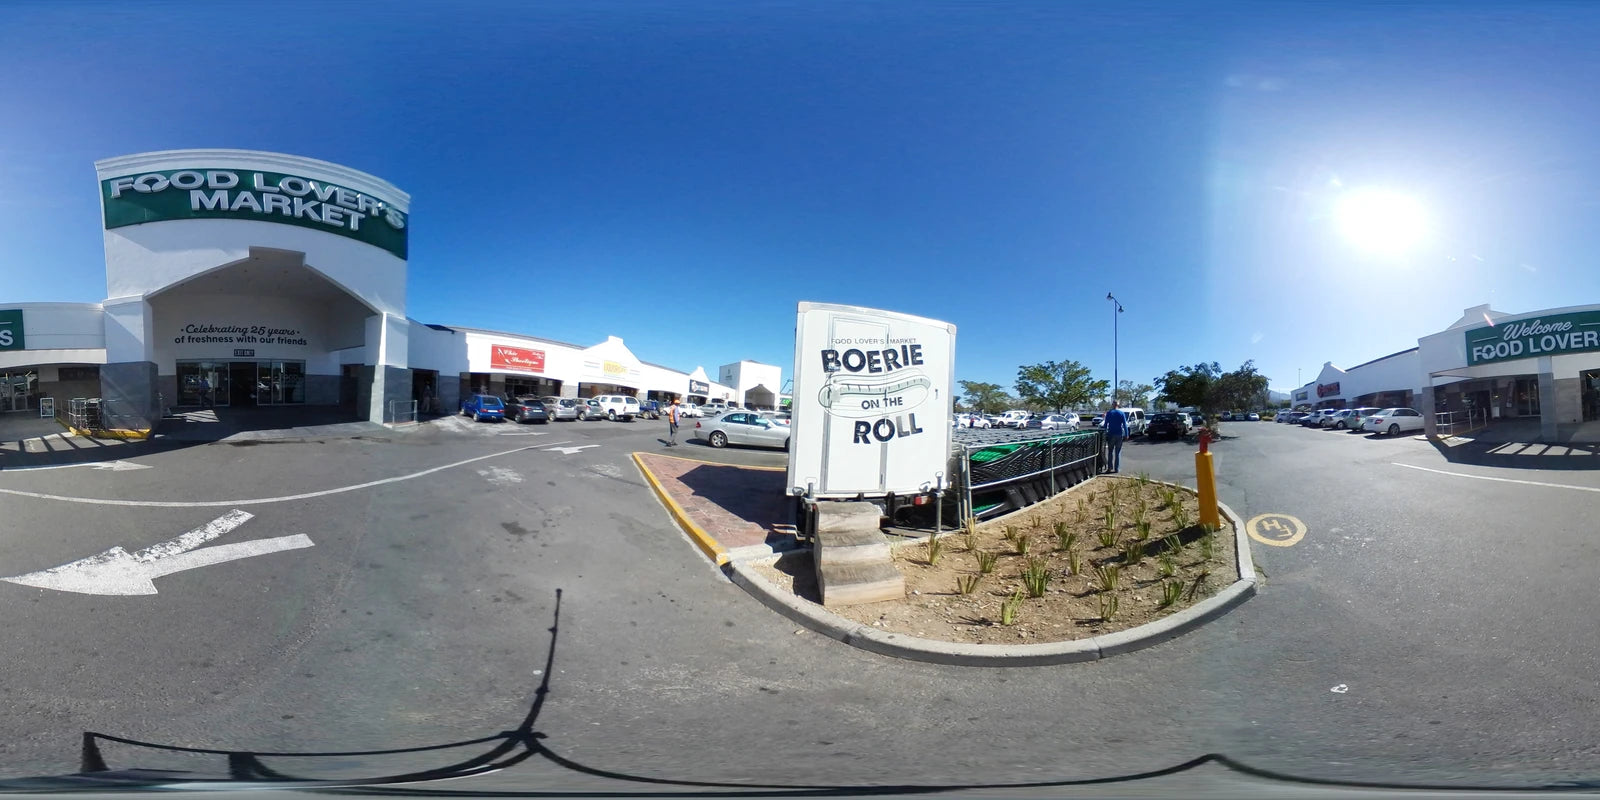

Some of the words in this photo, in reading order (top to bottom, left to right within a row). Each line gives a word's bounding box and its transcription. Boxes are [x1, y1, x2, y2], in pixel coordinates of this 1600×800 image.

[110, 170, 239, 198] FOOD
[254, 172, 405, 229] LOVER'S
[189, 189, 365, 231] MARKET
[174, 335, 185, 344] of
[187, 335, 234, 344] freshness
[236, 335, 257, 344] with
[259, 336, 275, 344] our
[277, 337, 307, 346] friends
[185, 324, 249, 336] Celebrating
[250, 325, 266, 336] 25
[267, 328, 296, 338] years
[1503, 319, 1573, 341] Welcome
[821, 344, 924, 373] BOERIE
[1473, 340, 1523, 362] FOOD
[1529, 330, 1600, 353] LOVER
[861, 400, 879, 410] ON
[884, 396, 903, 407] THE
[853, 413, 923, 444] ROLL
